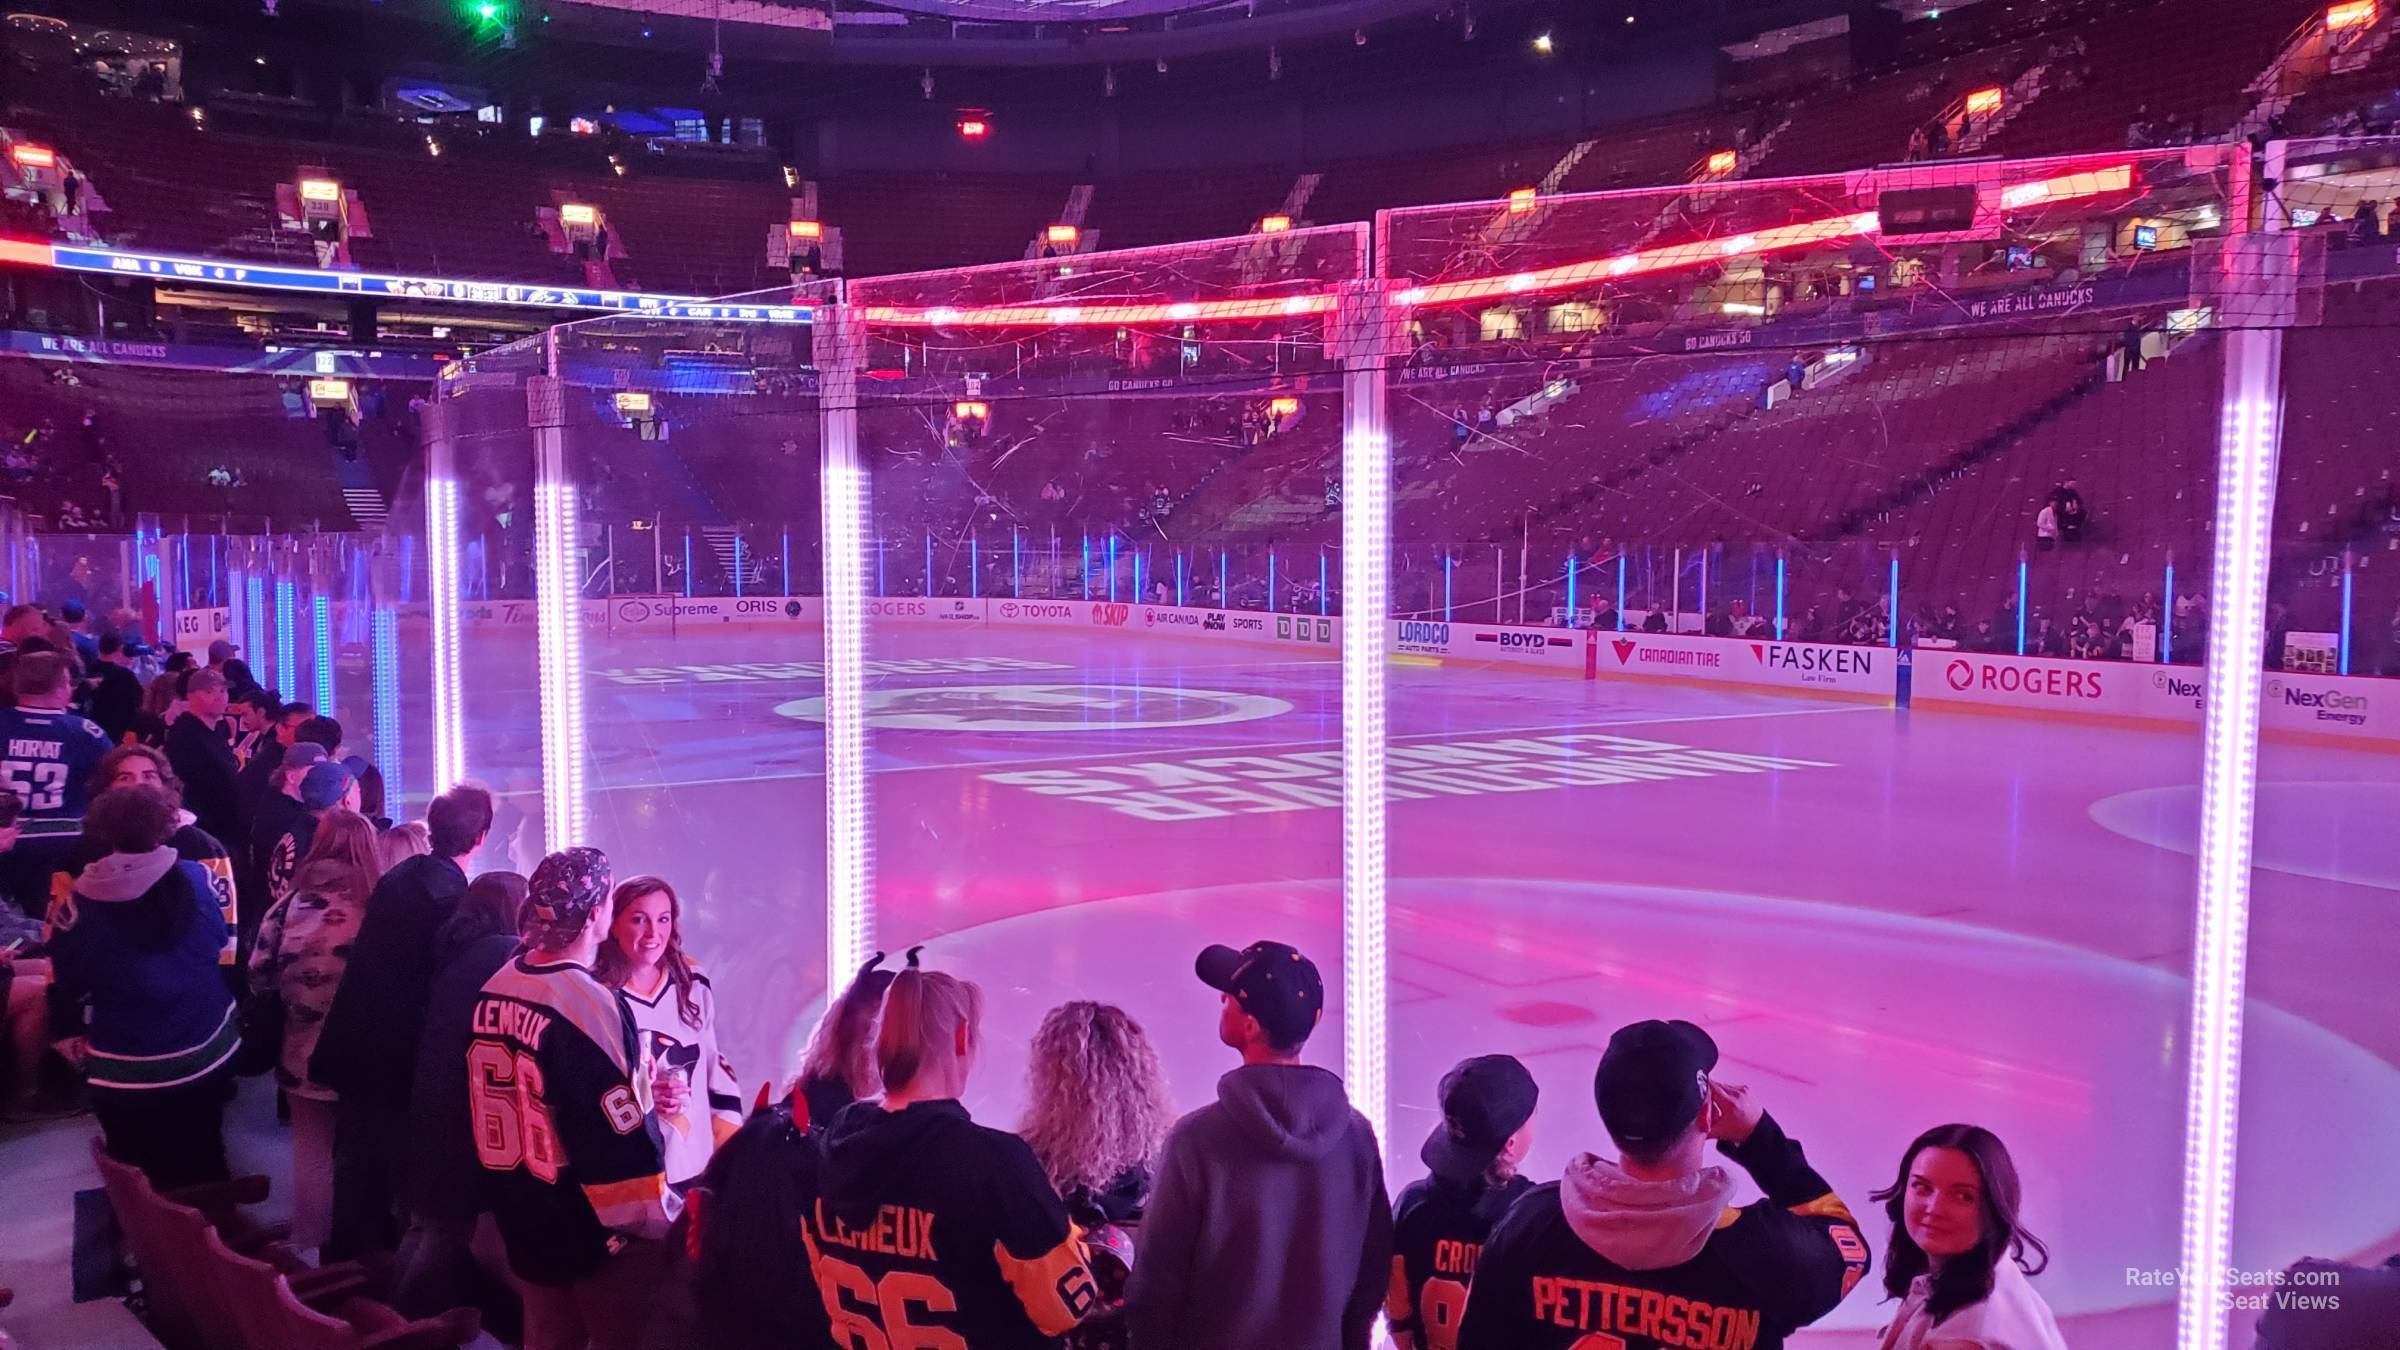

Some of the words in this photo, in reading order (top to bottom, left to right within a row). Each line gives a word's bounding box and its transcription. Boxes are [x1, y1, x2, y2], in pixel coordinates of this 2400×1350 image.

[1971, 301, 1986, 317] WE
[1990, 298, 2011, 315] ARE
[2015, 295, 2034, 311] ALL
[2038, 288, 2093, 309] CANUCKS
[41, 337, 59, 350] WE
[62, 339, 85, 352] ARE
[88, 341, 107, 353] ALL
[112, 342, 166, 358] CANUCKS
[1450, 364, 1486, 376] CANUCKS
[1108, 380, 1119, 391] GO
[1122, 380, 1160, 390] CANUCKS
[736, 600, 777, 613] ORIS
[868, 602, 926, 616] OGERS
[1022, 604, 1072, 618] TOYOTA
[1104, 603, 1128, 626] SKIP
[1156, 613, 1168, 623] AIR
[1168, 613, 1199, 625] CANADA
[1207, 613, 1225, 622] PLAY
[1208, 621, 1225, 631] NOW
[1233, 618, 1263, 630] SPORTS
[1399, 621, 1449, 645] LORDCO
[1500, 632, 1544, 647] BOYD
[1639, 647, 1693, 665] CANADIAN
[1694, 651, 1720, 667] TIRE
[1770, 645, 1871, 674] FASKEN
[1801, 673, 1815, 682] Law
[1818, 673, 1837, 683] Firm
[1982, 665, 2102, 698] ROGERS
[2168, 677, 2201, 698] Nex
[2285, 687, 2368, 710] NexGen
[2317, 709, 2367, 726] Energy
[8, 738, 64, 760] HORVAT
[1, 761, 69, 811] 53
[473, 1000, 551, 1051] LEMIEUX
[466, 1039, 558, 1186] 66
[600, 1084, 644, 1136] 6
[1532, 1276, 1761, 1350] PETTERSSON
